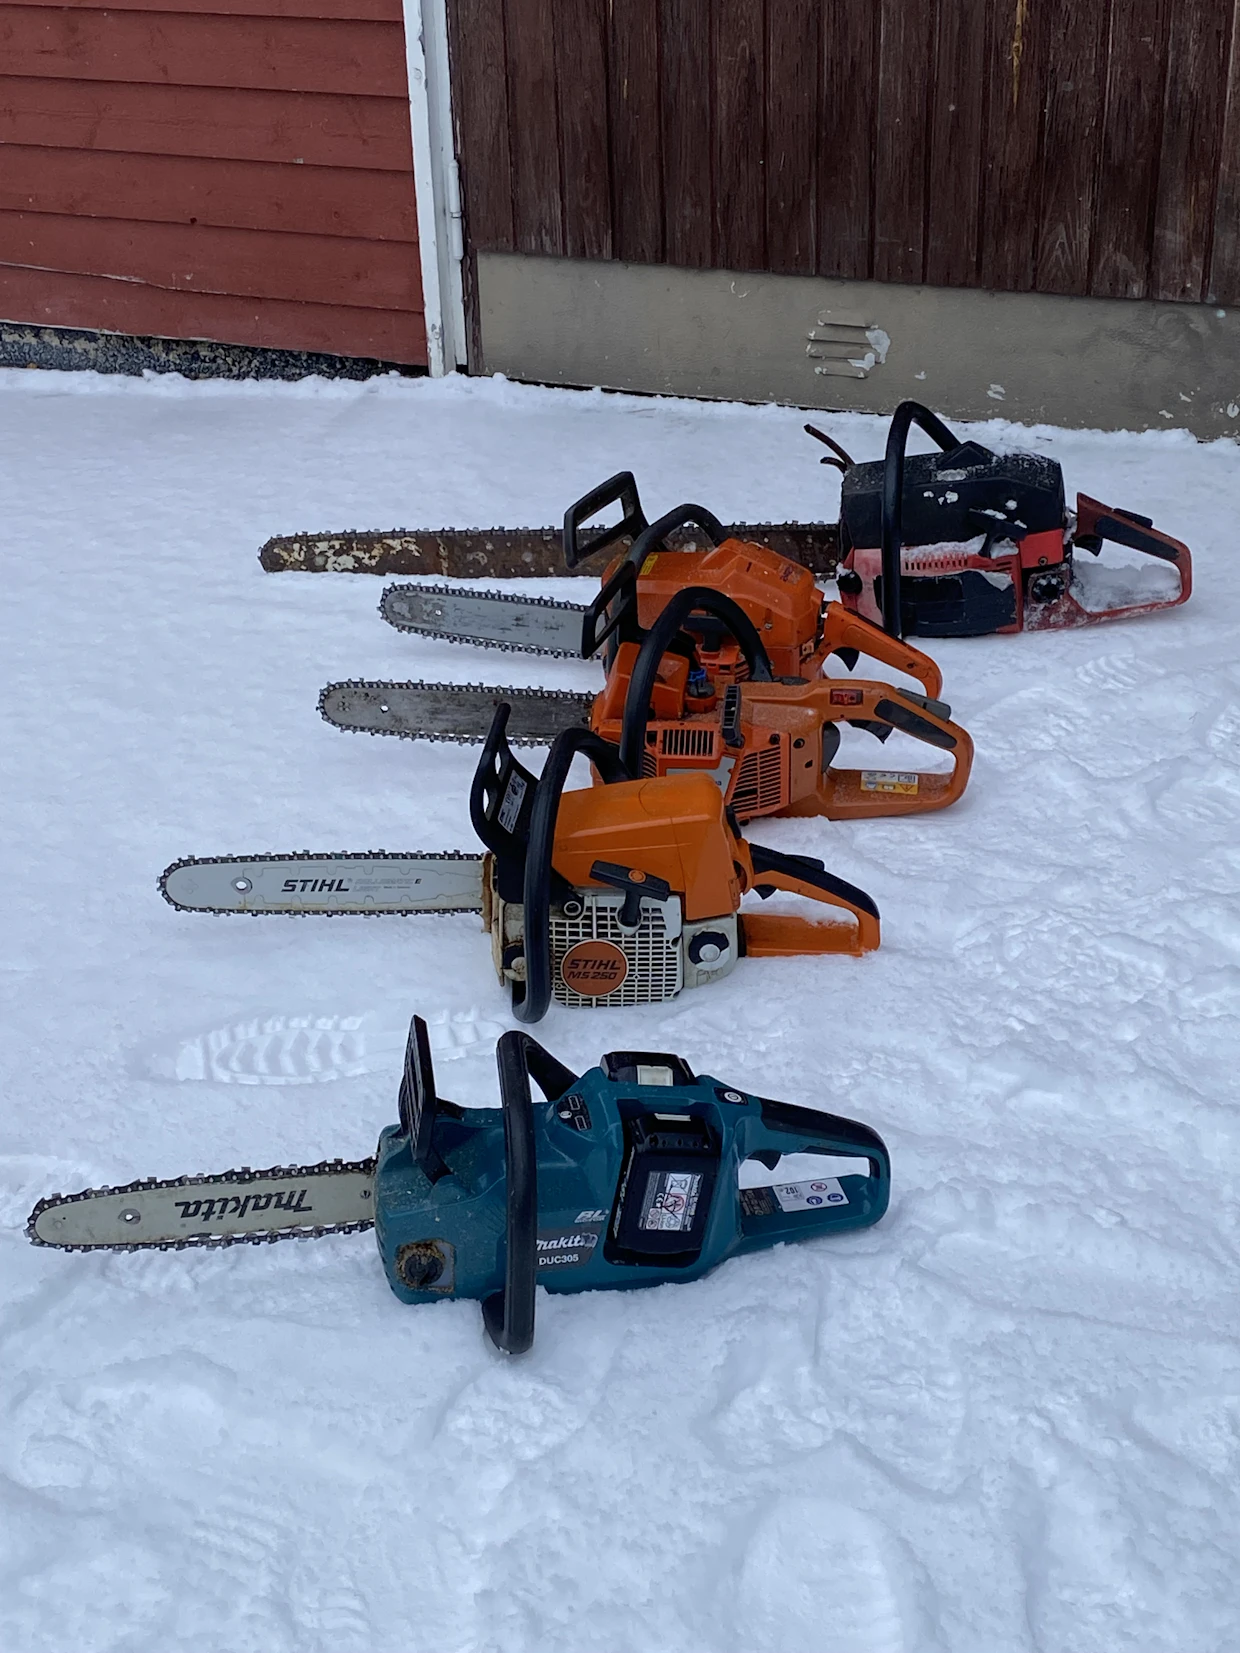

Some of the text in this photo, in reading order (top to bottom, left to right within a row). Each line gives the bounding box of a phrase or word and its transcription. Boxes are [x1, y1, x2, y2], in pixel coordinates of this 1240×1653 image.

[281, 878, 350, 893] STIHL
[567, 959, 621, 970] STIHL
[567, 971, 618, 980] MS 250
[538, 1253, 579, 1266] DUC305
